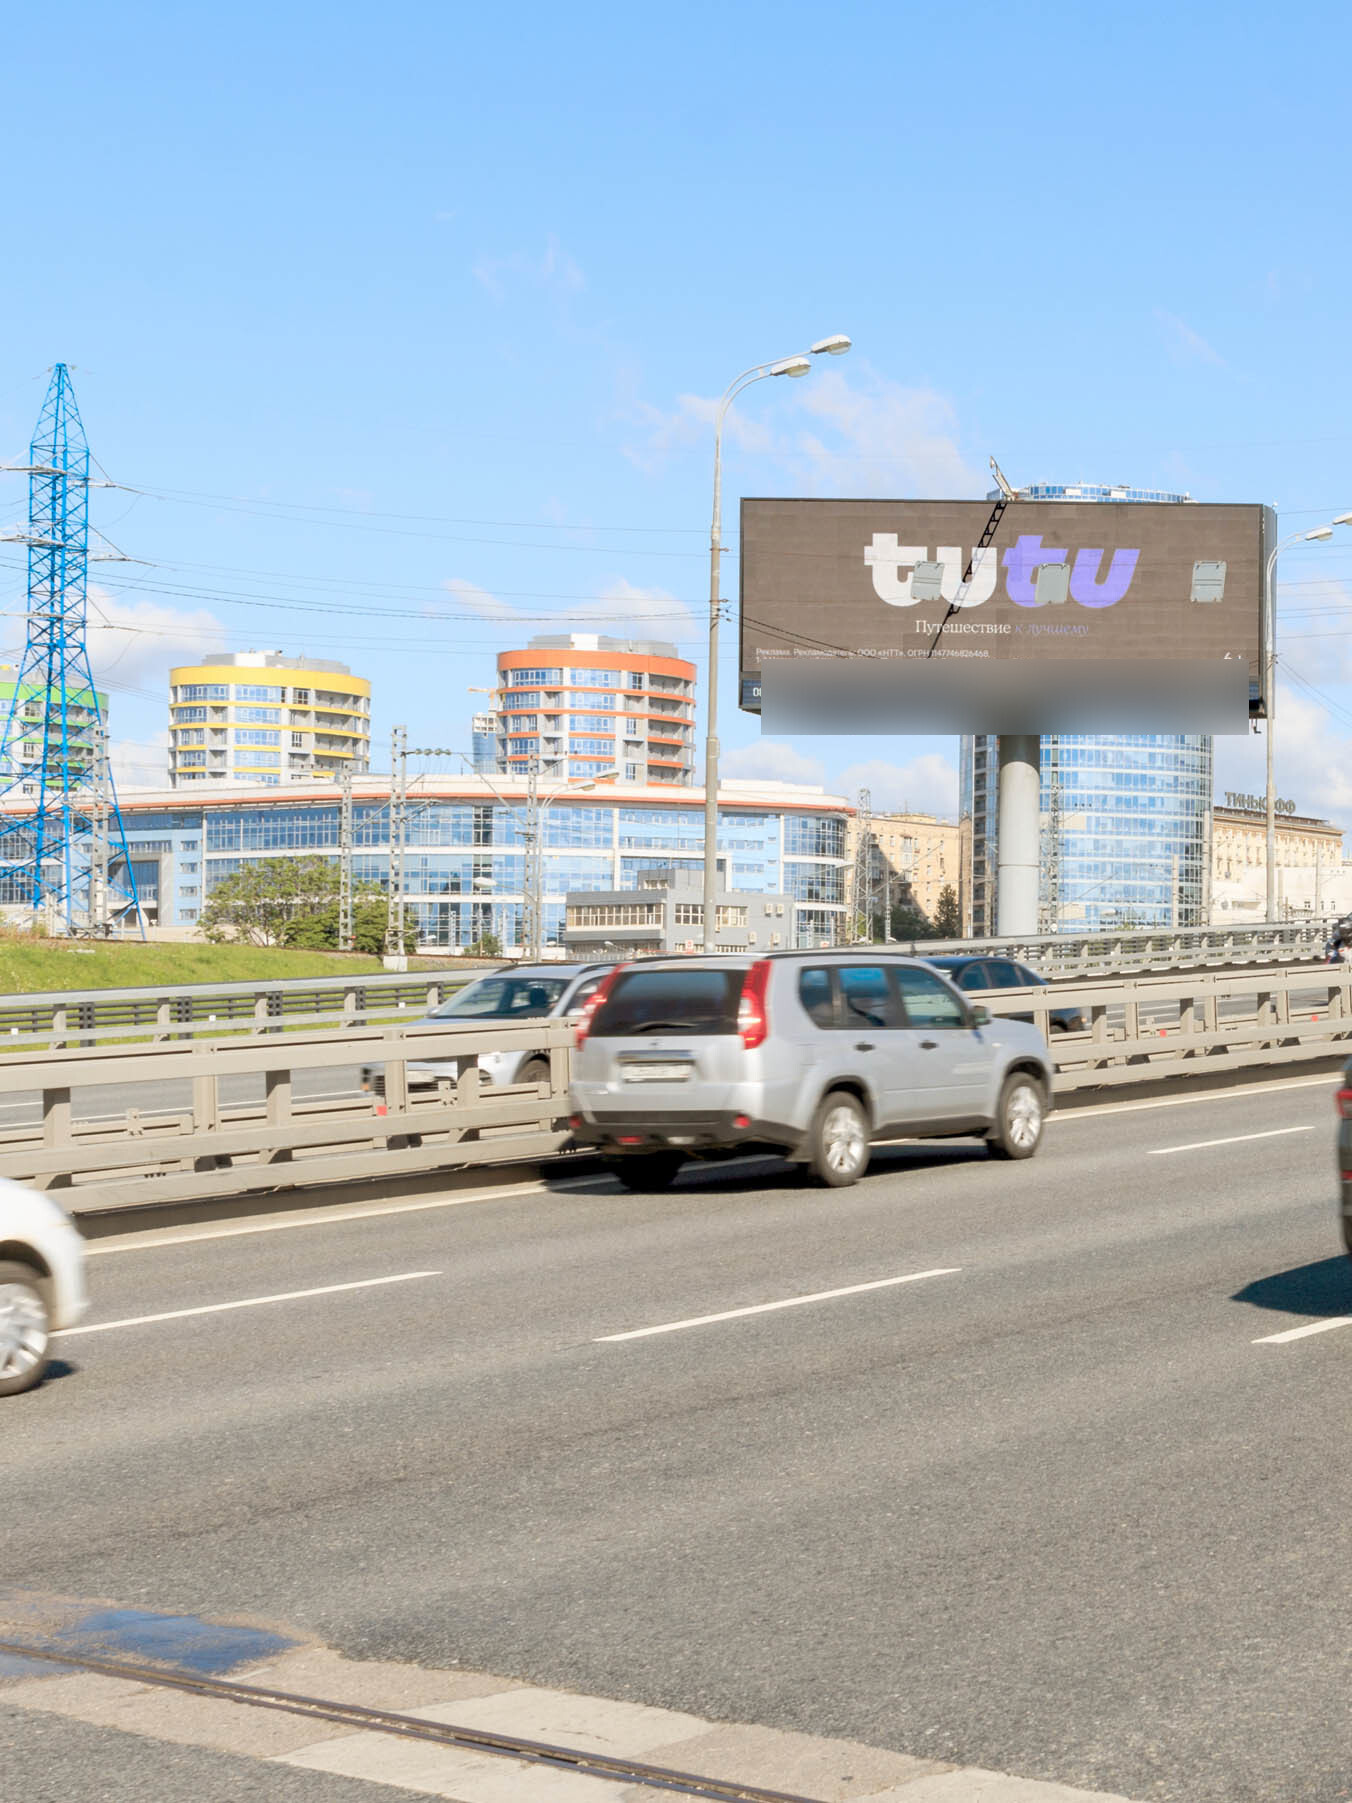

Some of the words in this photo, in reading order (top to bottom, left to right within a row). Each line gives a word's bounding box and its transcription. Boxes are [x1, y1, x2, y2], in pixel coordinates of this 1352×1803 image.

[864, 533, 1141, 608] tutu
[916, 620, 1011, 635] Путешествие
[1015, 624, 1022, 633] к
[1029, 624, 1089, 635] лучшему
[1224, 792, 1296, 814] ТИНЬКФФ
